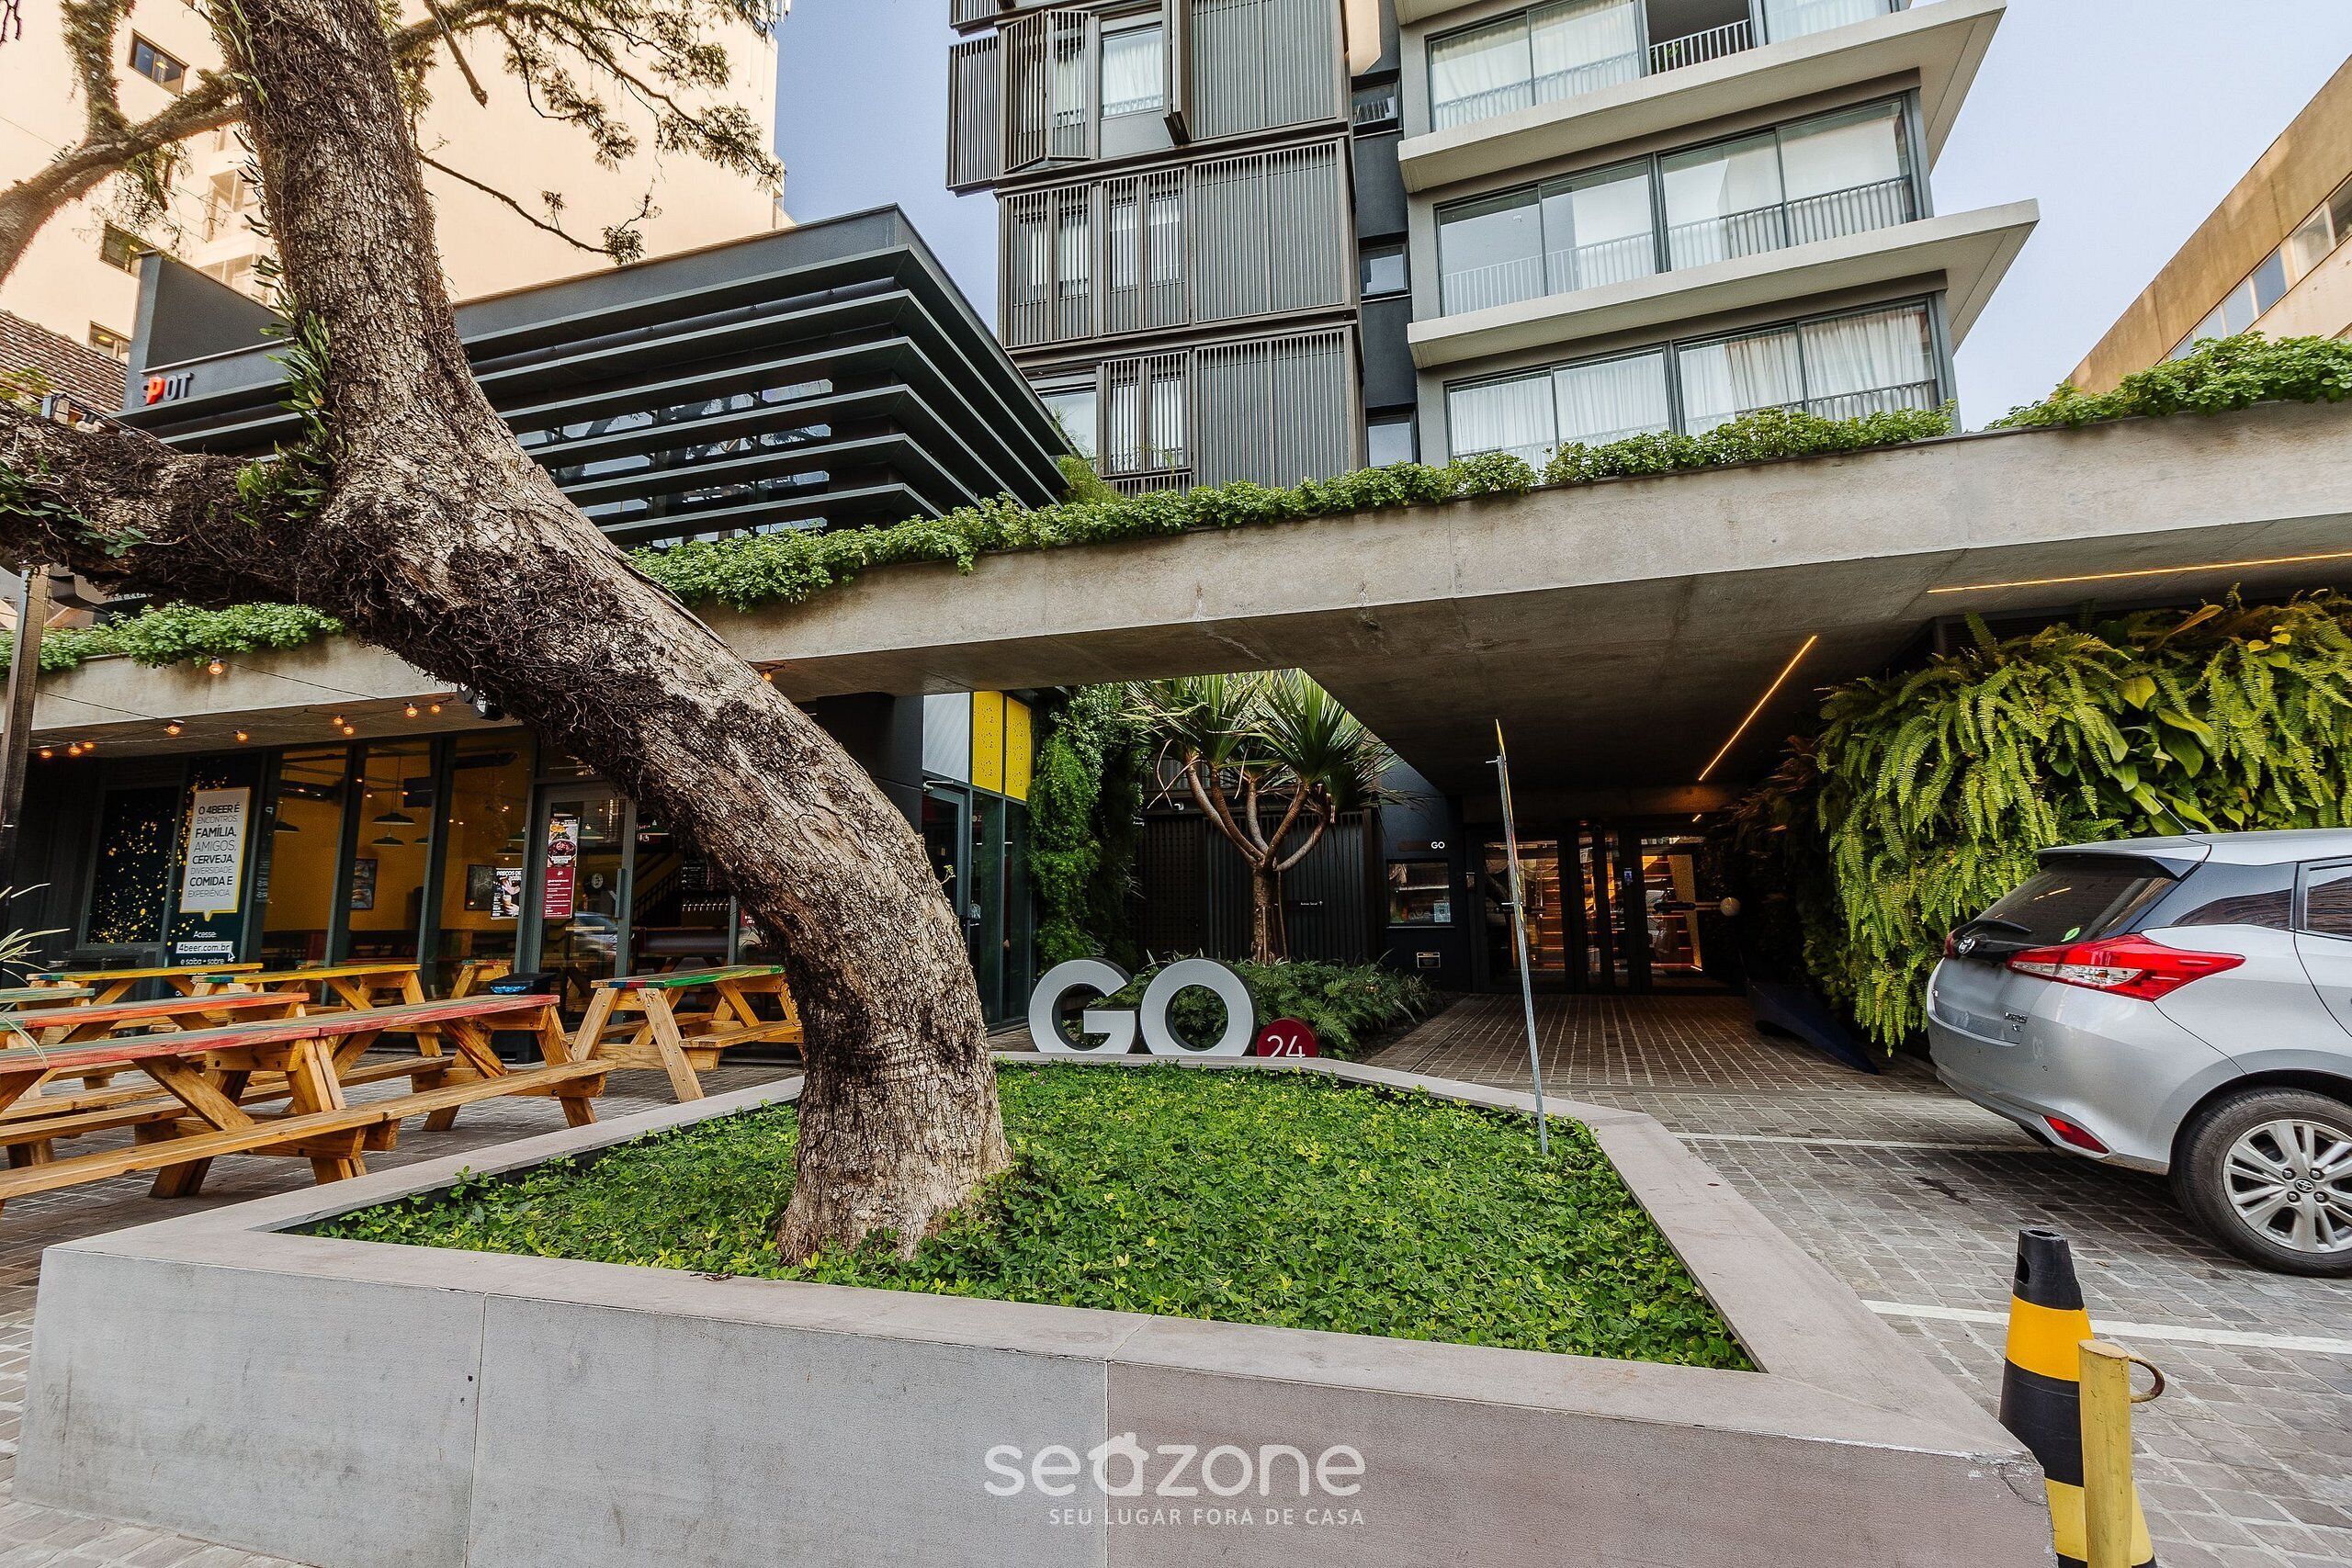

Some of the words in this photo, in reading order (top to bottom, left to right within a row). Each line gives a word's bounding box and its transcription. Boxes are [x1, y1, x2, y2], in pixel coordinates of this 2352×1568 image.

[198, 807, 205, 815] O
[206, 805, 233, 814] 4BEER
[234, 802, 240, 812] É
[196, 824, 236, 838] FAMÍLIA,
[189, 876, 225, 886] COMIDA
[227, 876, 233, 885] E
[178, 942, 230, 952] 4beer.com.br
[1029, 958, 1255, 1056] GO
[1267, 1035, 1306, 1057] 24
